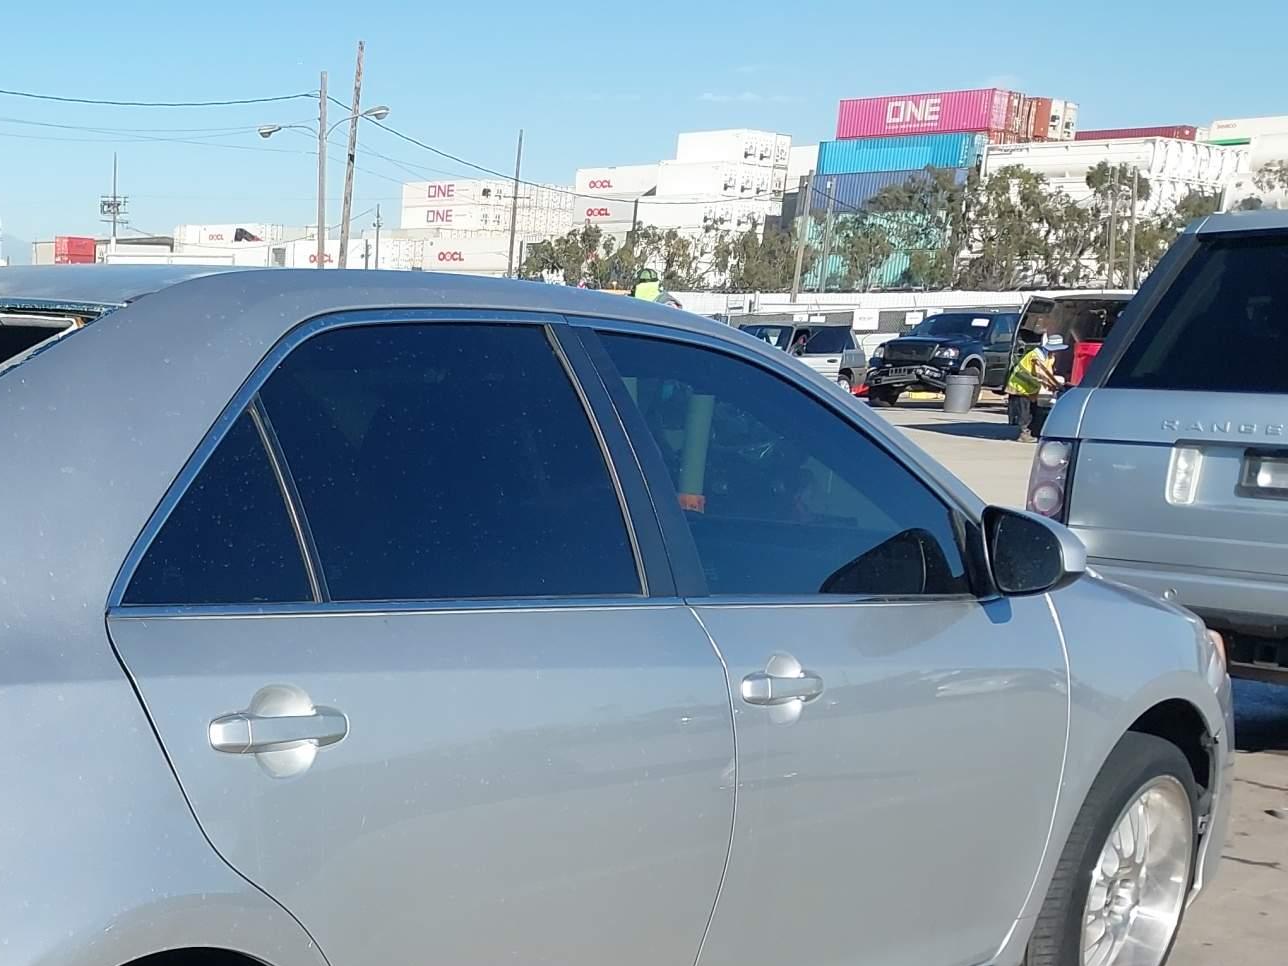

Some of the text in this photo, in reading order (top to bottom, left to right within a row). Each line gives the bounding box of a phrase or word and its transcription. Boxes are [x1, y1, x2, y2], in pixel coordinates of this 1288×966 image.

[886, 98, 941, 123] ONE
[427, 183, 455, 198] ONE
[589, 179, 613, 189] OOCL
[426, 209, 453, 223] ONE
[586, 207, 611, 217] OOCL
[438, 251, 464, 262] OOCL
[1161, 419, 1284, 436] RANGE
